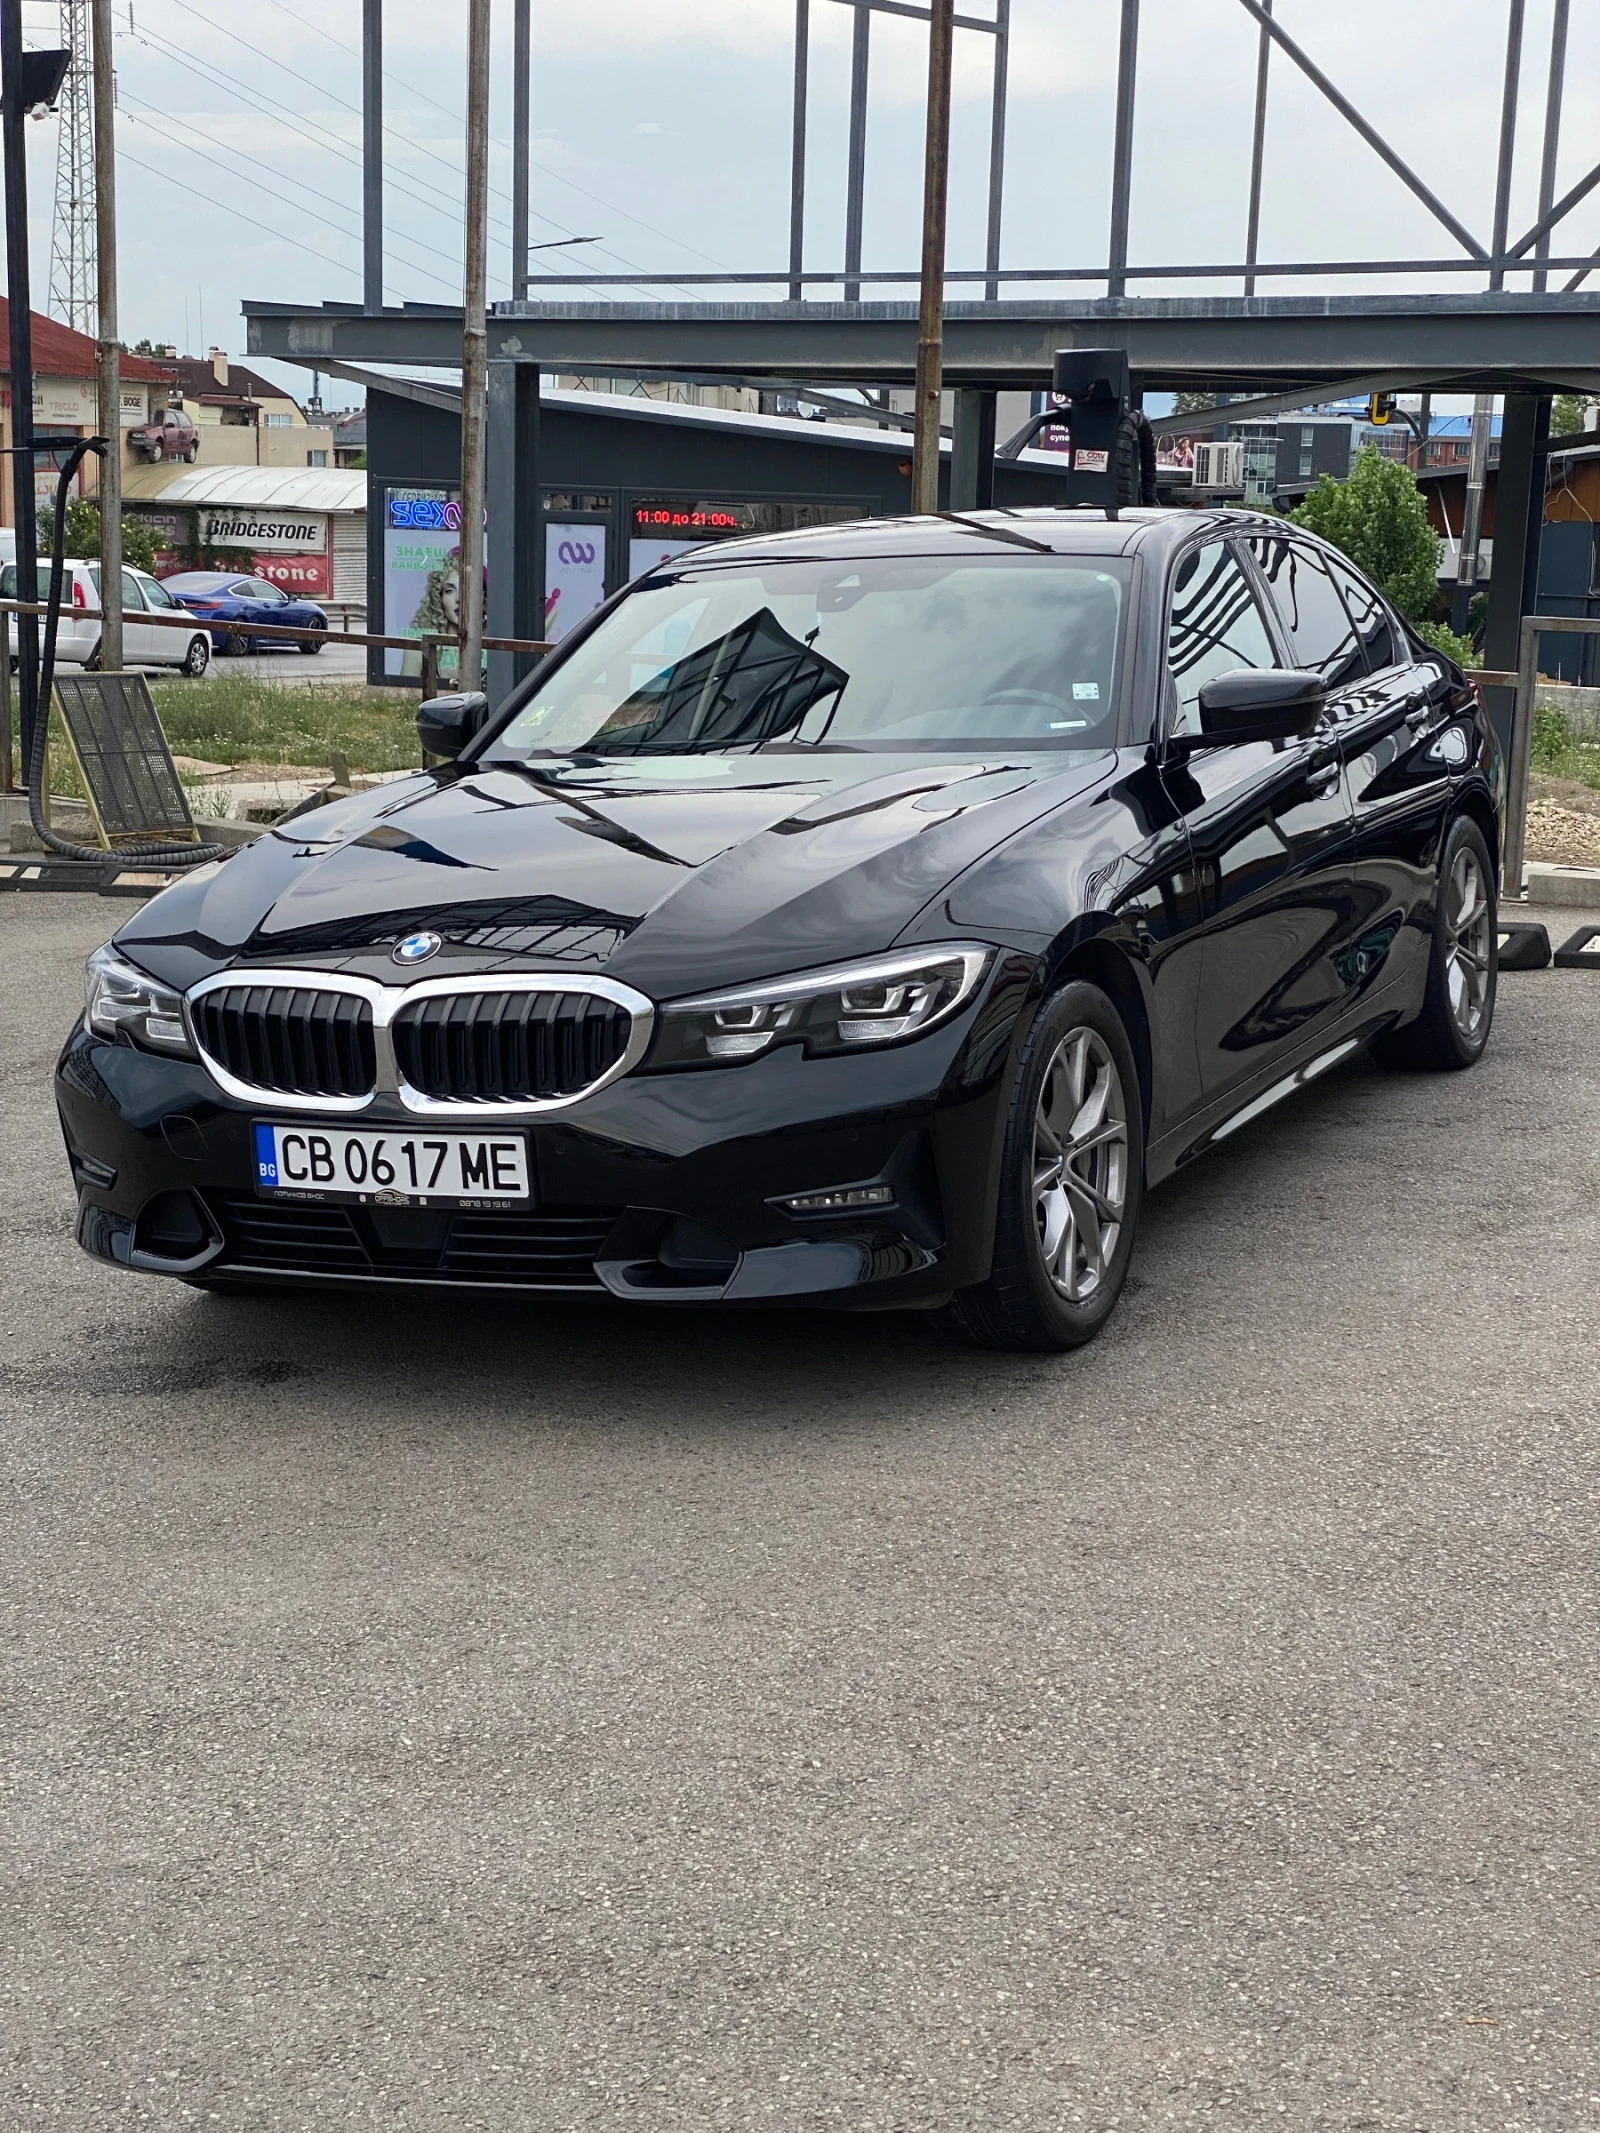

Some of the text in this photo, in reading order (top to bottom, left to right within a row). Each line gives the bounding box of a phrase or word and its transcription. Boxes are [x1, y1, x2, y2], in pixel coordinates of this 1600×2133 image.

[1087, 451, 1105, 459] CCTV
[636, 510, 738, 526] 11:00 до 21:00ч.
[211, 519, 317, 540] BRIDGESTONE
[391, 560, 429, 570] КАКВО
[259, 1162, 276, 1177] BG
[281, 1134, 521, 1191] CB 0617 ME
[459, 1199, 481, 1207] 0878
